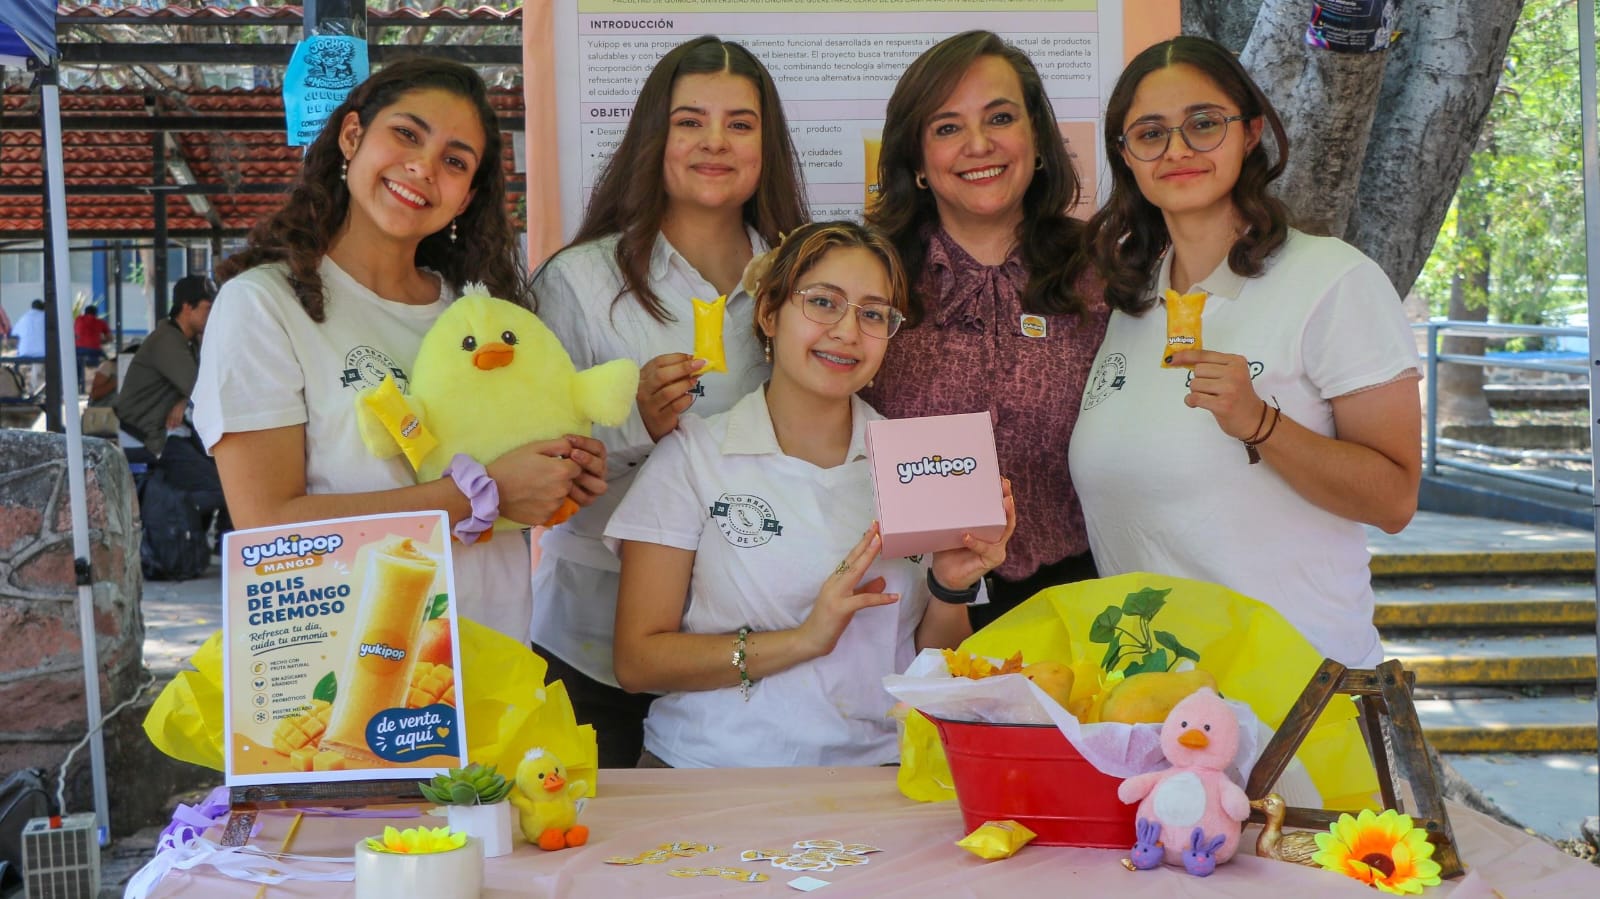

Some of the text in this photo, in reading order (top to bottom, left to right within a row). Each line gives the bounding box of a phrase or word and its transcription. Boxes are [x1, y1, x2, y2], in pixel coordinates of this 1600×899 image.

[590, 18, 674, 28] INTRODUCCIÓN
[310, 38, 353, 54] JOCHOS
[588, 41, 620, 49] Yukipop
[886, 40, 922, 48] respuesta
[1054, 38, 1092, 47] productos
[588, 64, 642, 72] incorporación
[834, 62, 874, 71] tecnología
[1057, 62, 1092, 70] producto
[806, 126, 842, 134] producto
[808, 148, 842, 156] ciudades
[1168, 336, 1194, 345] yukipop
[897, 455, 976, 484] yukipop
[747, 498, 772, 518] BRAVO
[242, 534, 343, 567] yukipop
[264, 558, 314, 572] MANGO
[246, 576, 305, 597] BOLIS
[248, 584, 350, 612] DE MANGO
[248, 600, 345, 626] CREMOSO
[249, 628, 290, 642] Refresca
[250, 638, 275, 651] cuida
[290, 630, 328, 642] armonía
[360, 644, 406, 660] yukipop
[376, 712, 442, 734] de venta
[396, 726, 434, 750] aquí
